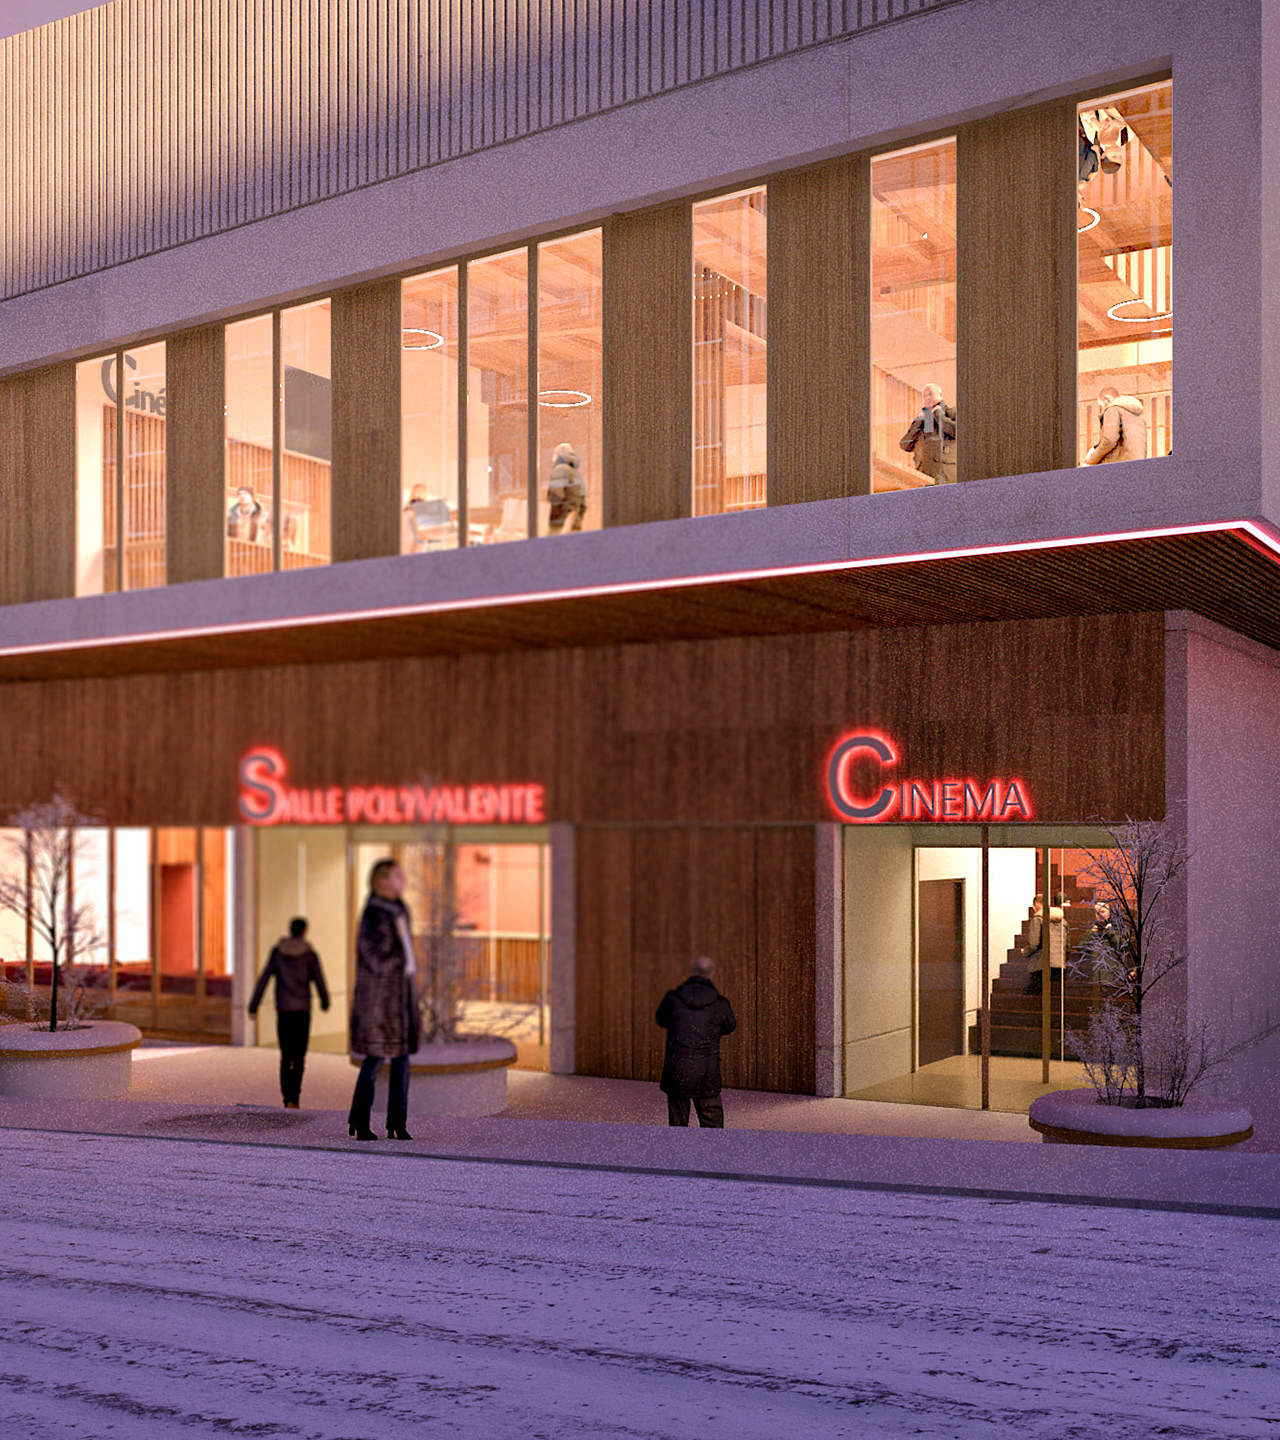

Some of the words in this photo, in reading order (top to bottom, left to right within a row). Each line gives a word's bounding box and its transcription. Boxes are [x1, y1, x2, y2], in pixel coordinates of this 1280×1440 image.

[238, 747, 344, 824] SALLE
[345, 784, 546, 823] POLYVALENTE
[827, 734, 1029, 819] CINEMA
